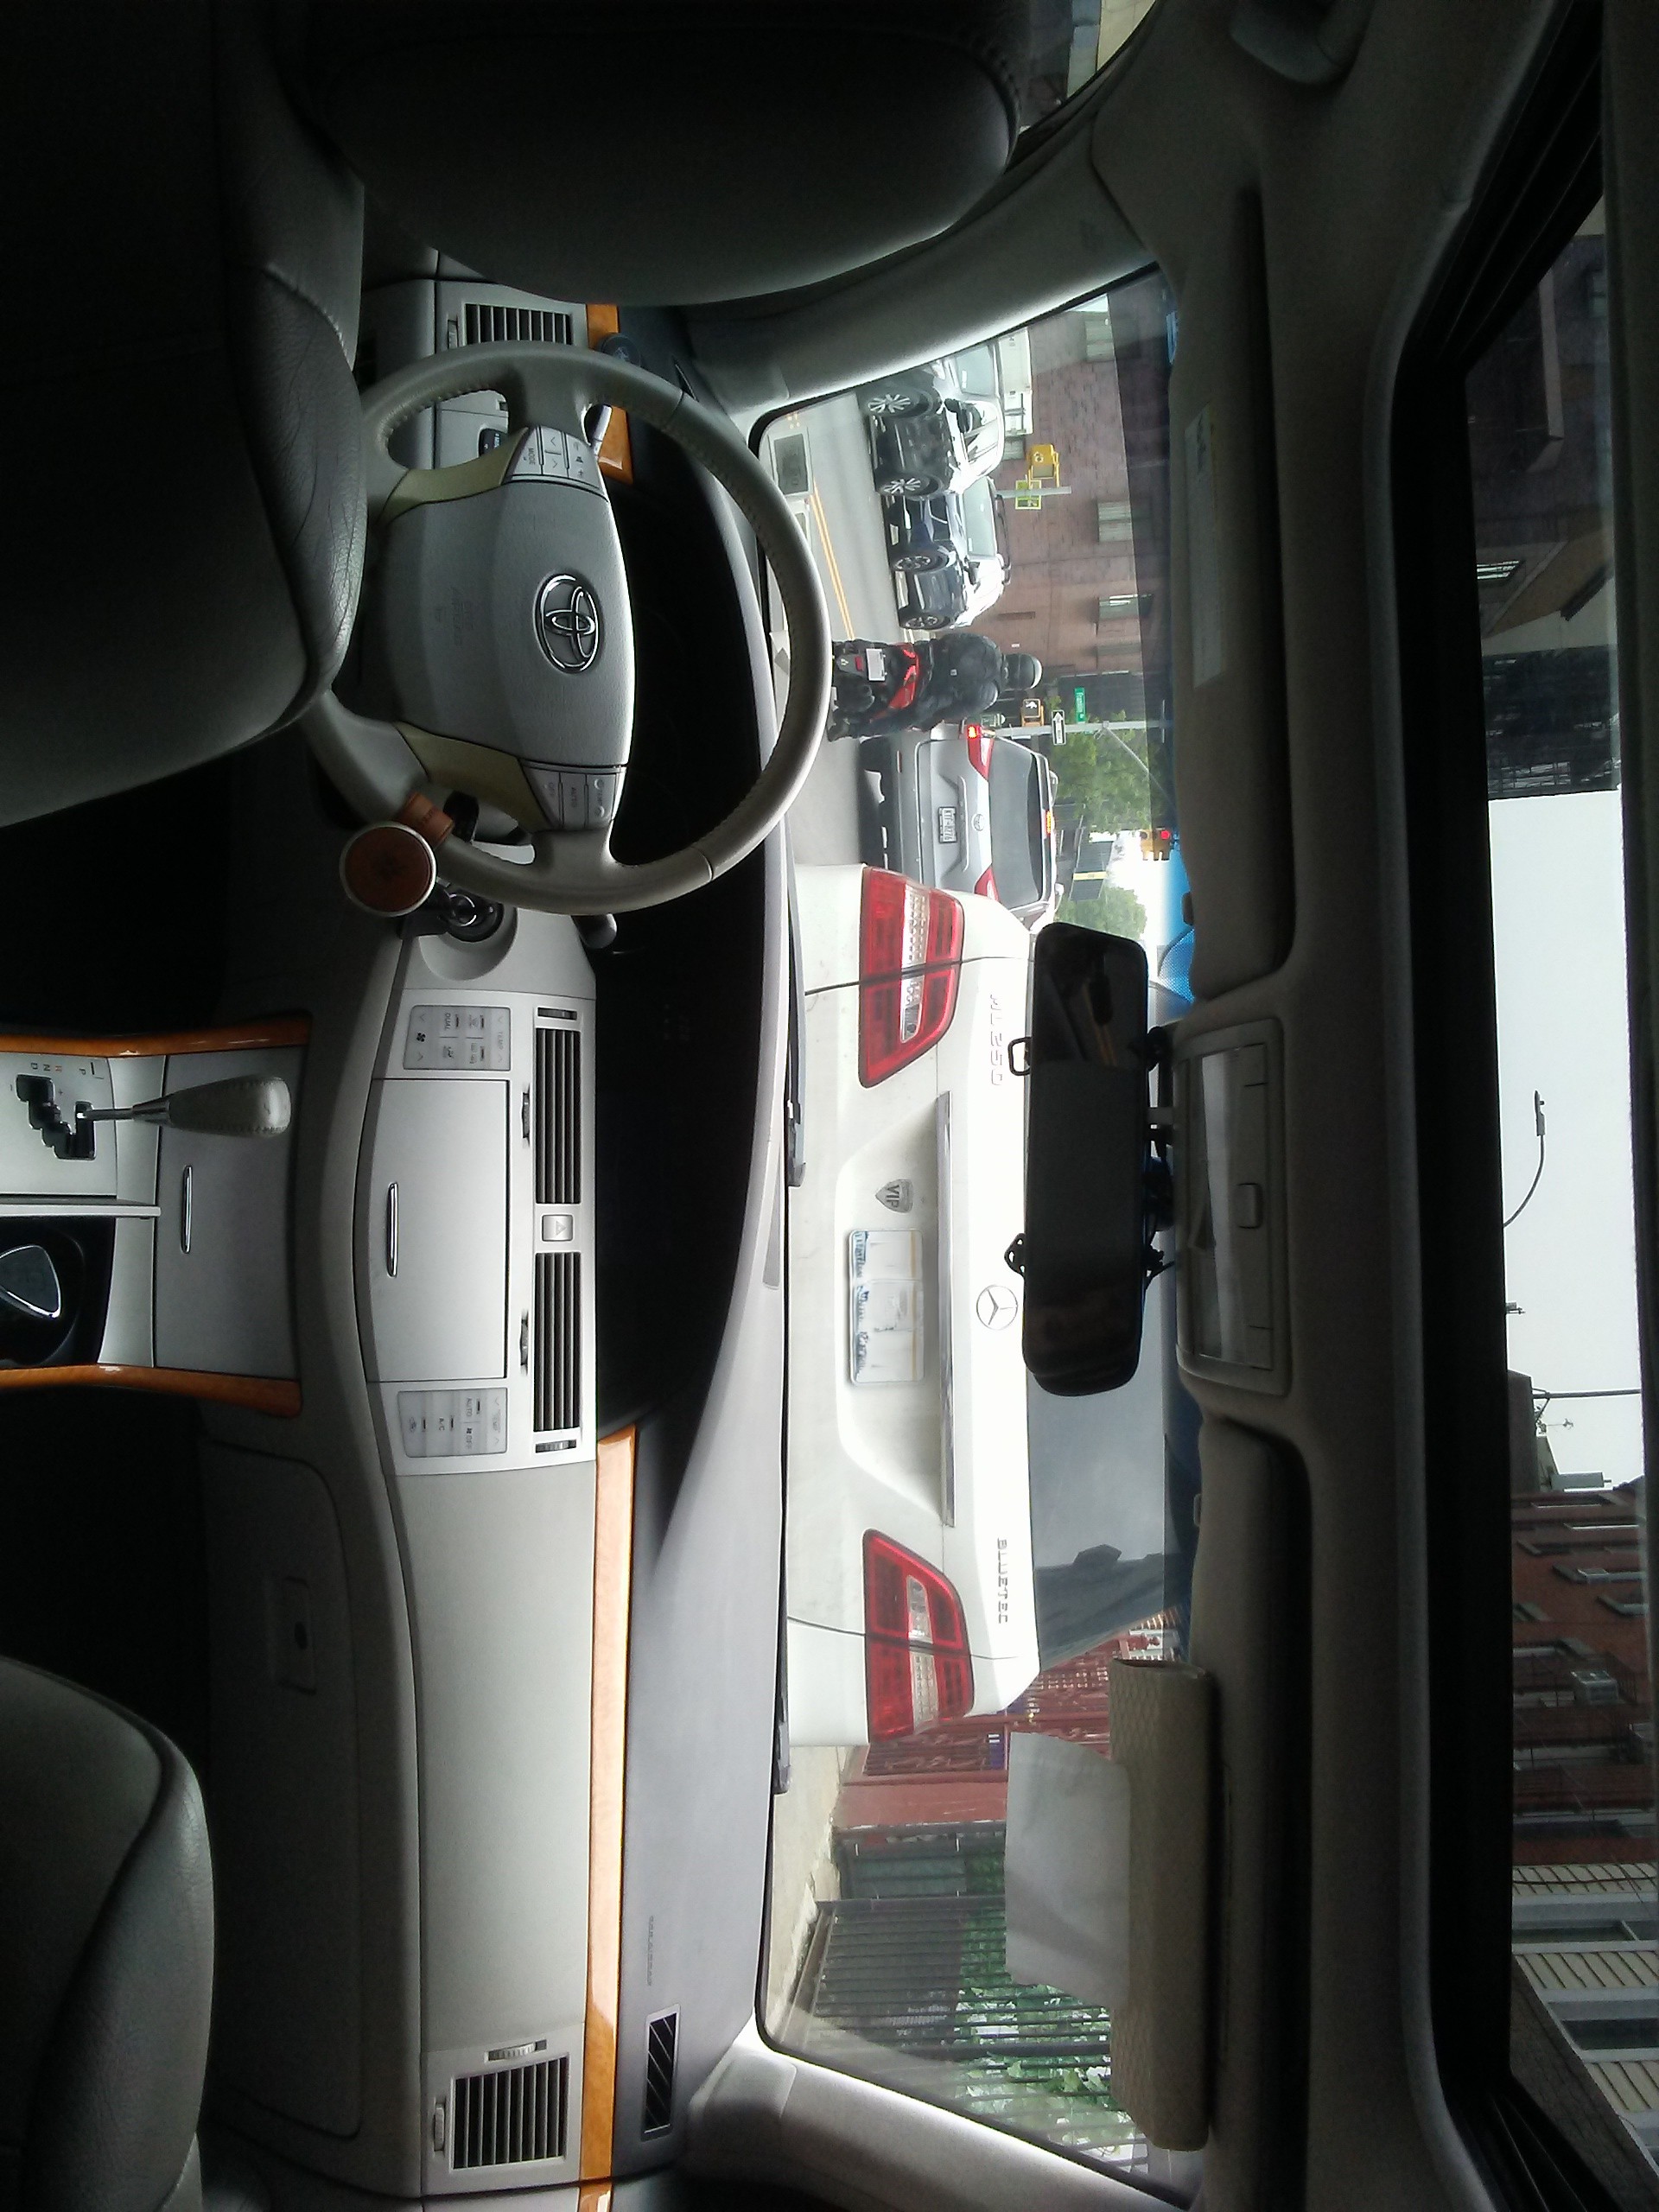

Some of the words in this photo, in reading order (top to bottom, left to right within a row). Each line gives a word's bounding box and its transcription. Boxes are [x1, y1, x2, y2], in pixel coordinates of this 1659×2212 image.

[990, 994, 1002, 1026] ML
[990, 1031, 1002, 1086] 250
[887, 1184, 899, 1208] VIP
[997, 1538, 1008, 1624] BLUETEC
